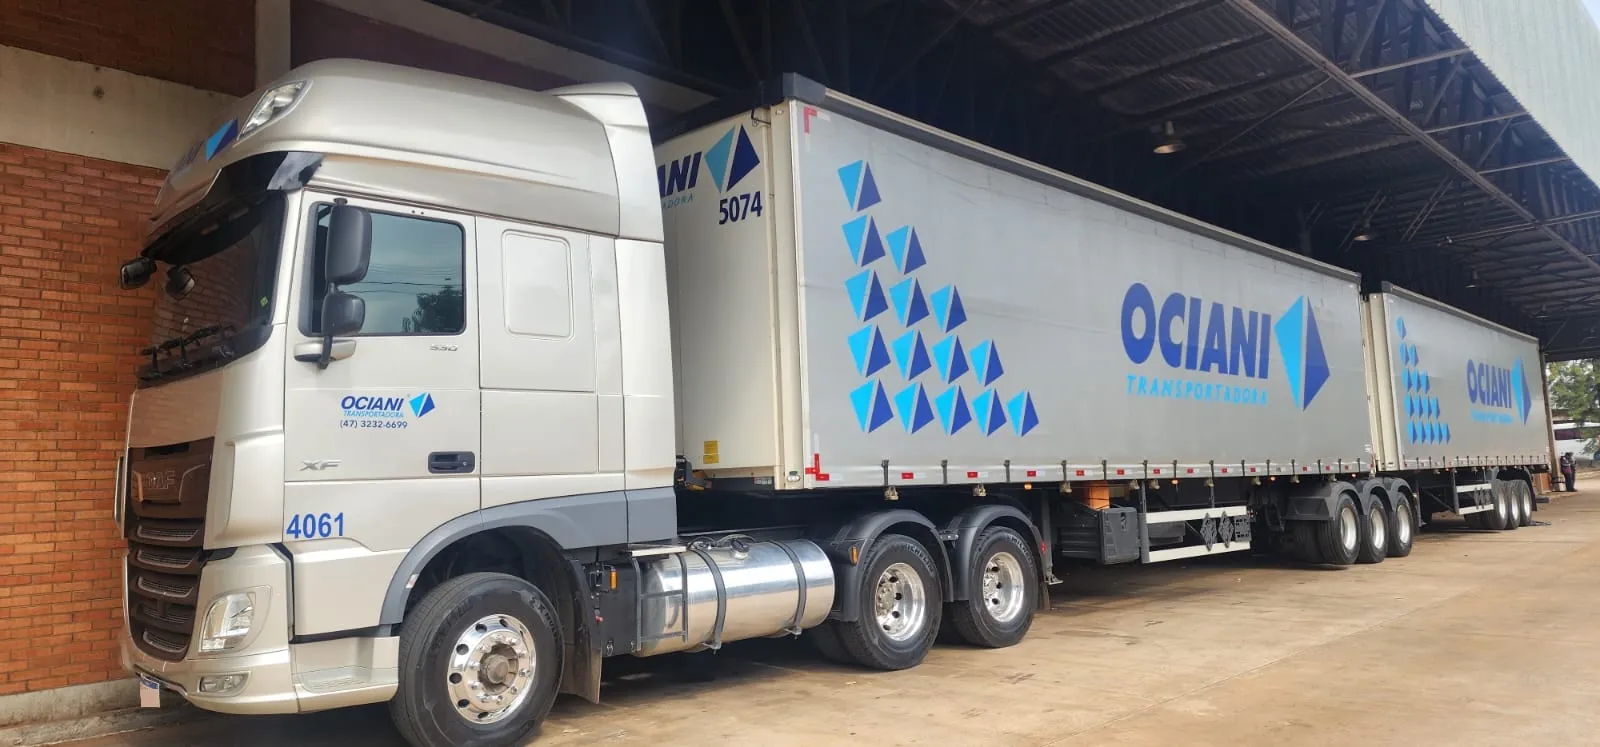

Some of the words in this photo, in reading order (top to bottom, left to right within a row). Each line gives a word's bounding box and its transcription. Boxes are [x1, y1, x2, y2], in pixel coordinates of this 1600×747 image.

[719, 190, 763, 225] 5074
[1121, 282, 1272, 380] OCIANI
[1127, 375, 1268, 406] TRANSPORTADORA
[1466, 359, 1512, 409] OCIANI
[341, 395, 404, 411] OCIANI
[343, 410, 404, 418] TRANSPORTADORA
[340, 420, 358, 429] (47)
[361, 420, 408, 429] 3232-6699
[299, 459, 343, 471] XF
[286, 512, 344, 538] 4061
